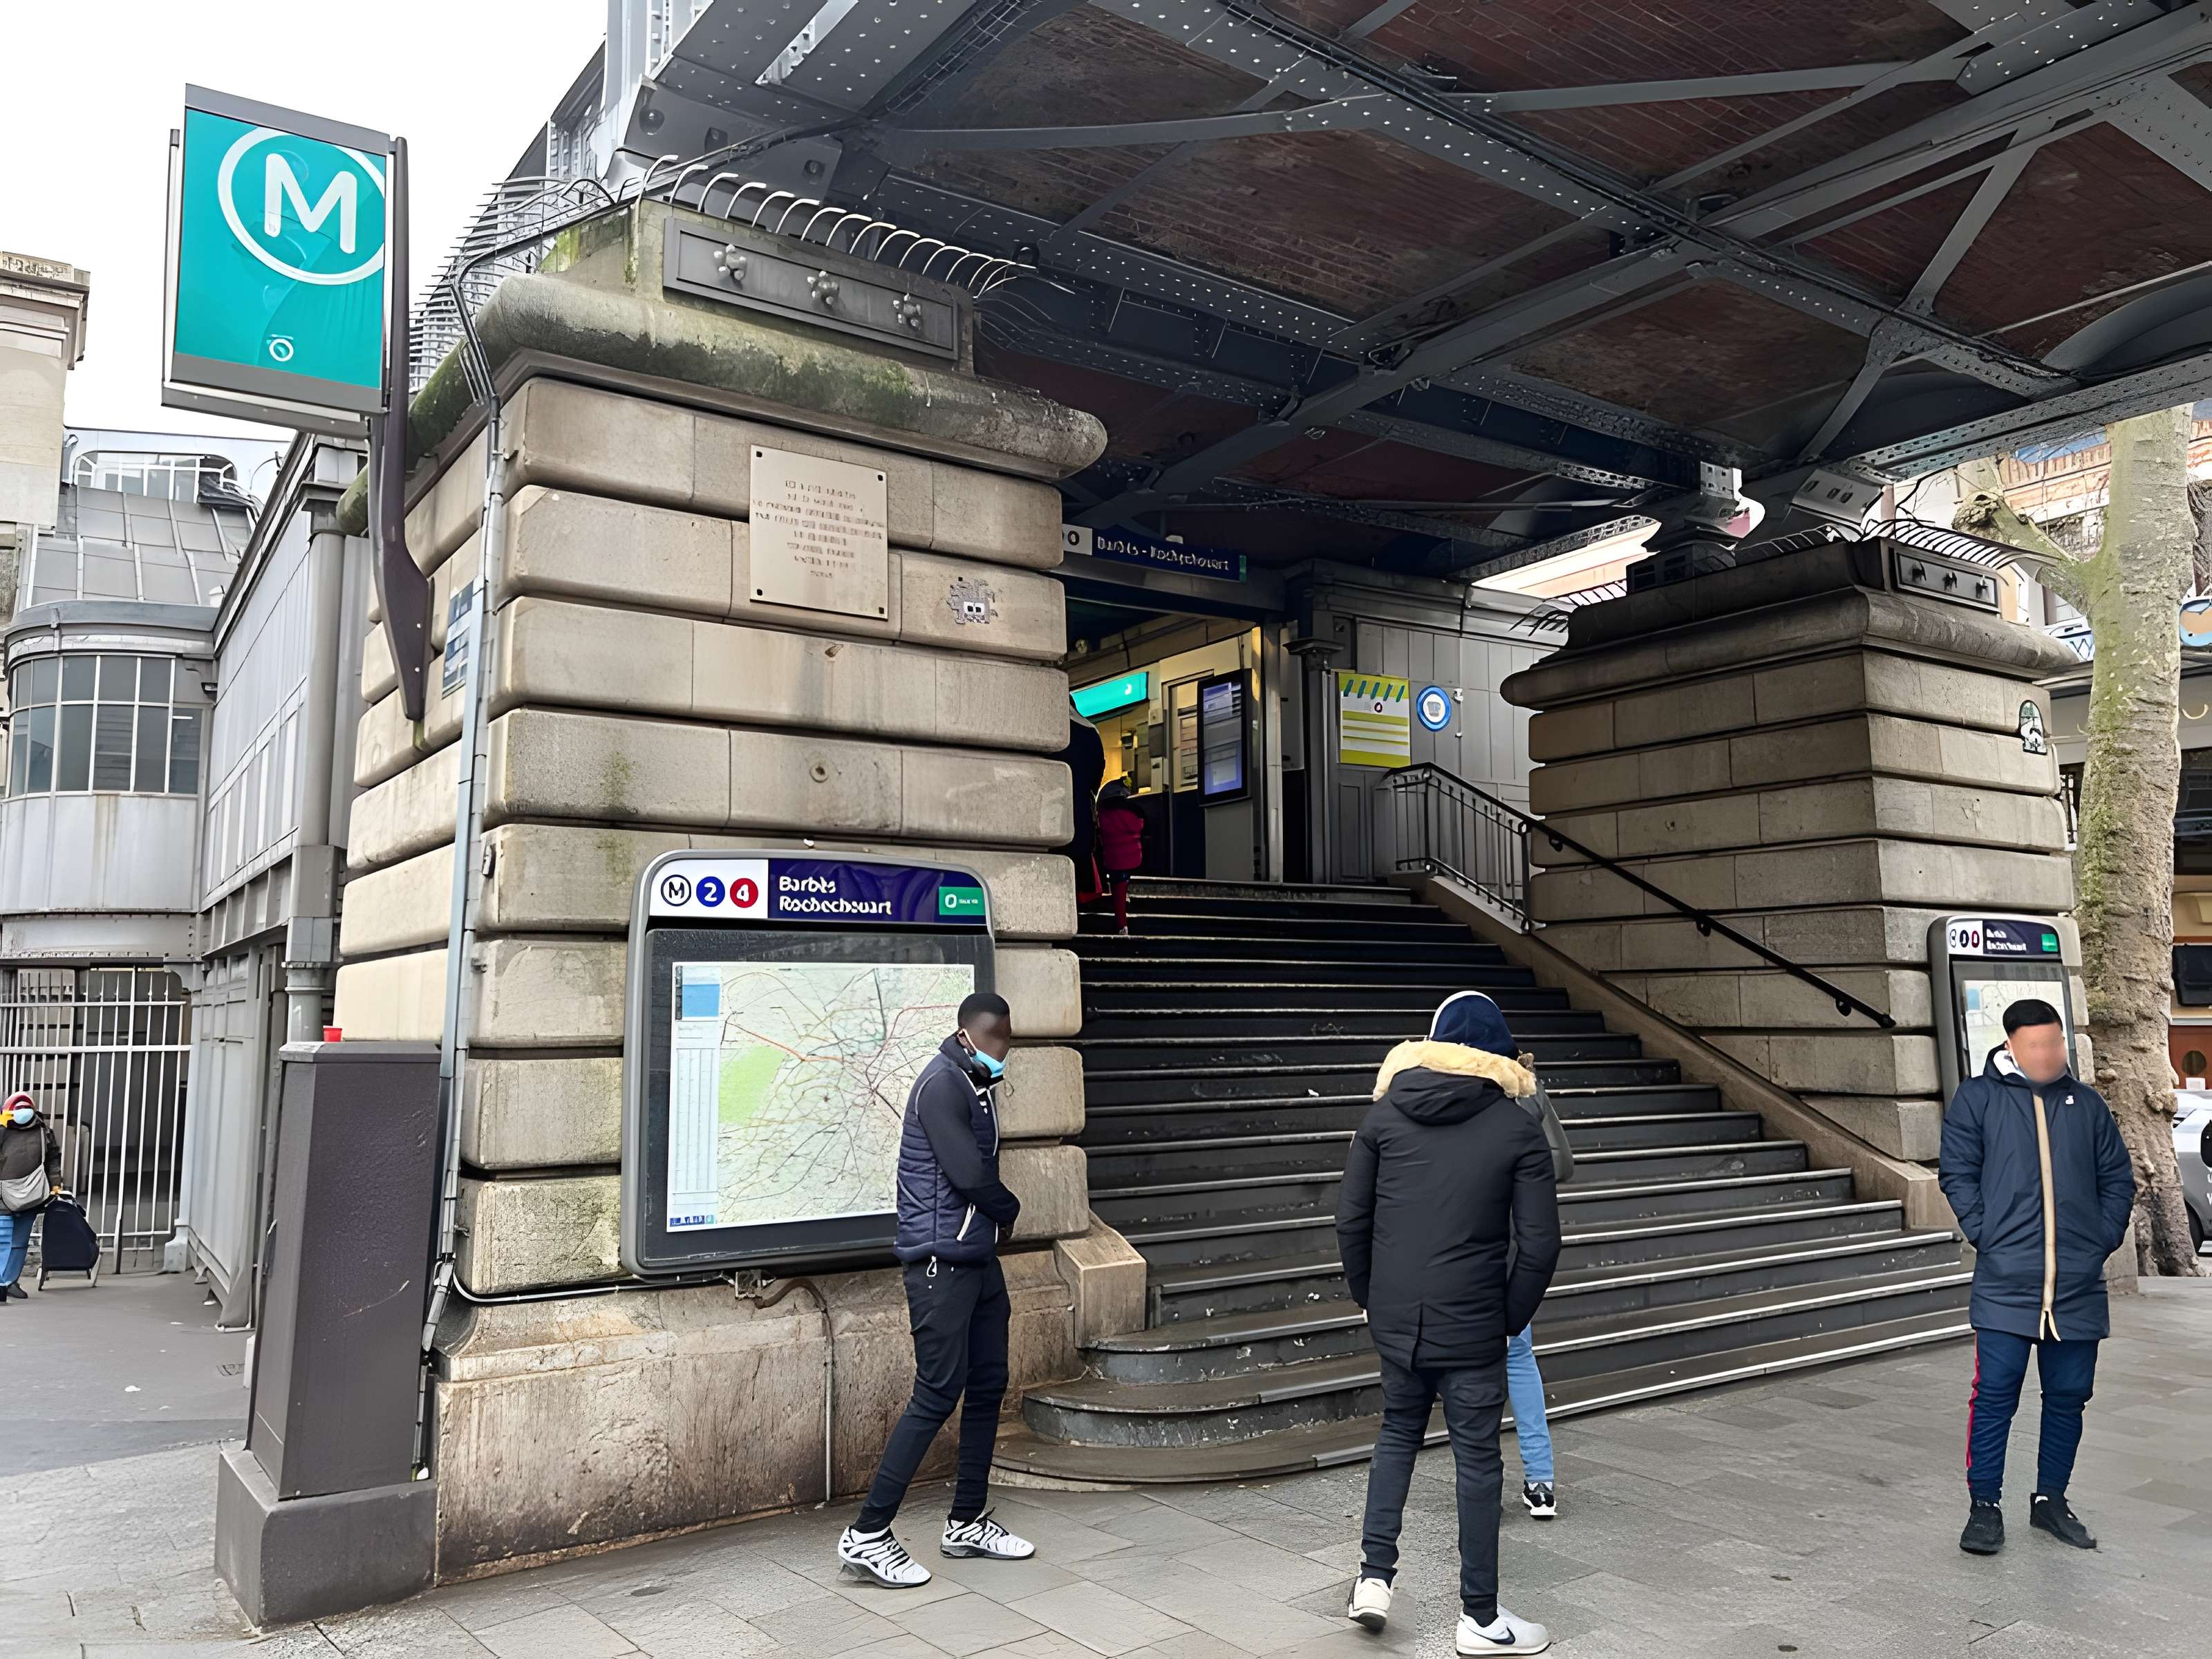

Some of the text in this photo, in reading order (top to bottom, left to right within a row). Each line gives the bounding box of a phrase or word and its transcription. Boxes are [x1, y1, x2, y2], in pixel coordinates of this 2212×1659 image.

[264, 153, 357, 254] M
[668, 881, 685, 899] M
[704, 882, 718, 902] 2
